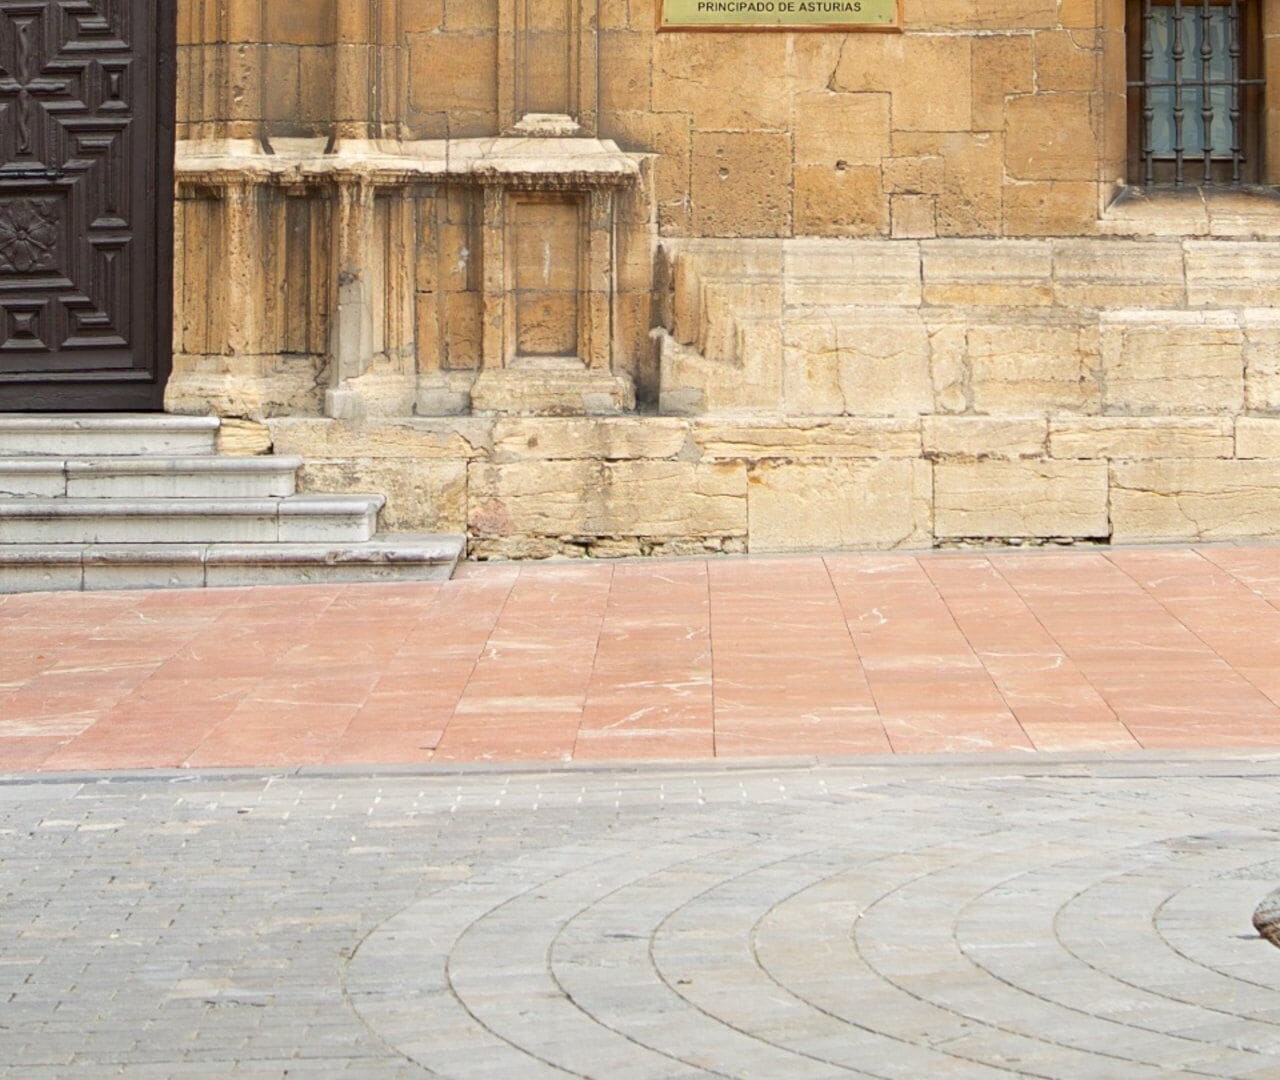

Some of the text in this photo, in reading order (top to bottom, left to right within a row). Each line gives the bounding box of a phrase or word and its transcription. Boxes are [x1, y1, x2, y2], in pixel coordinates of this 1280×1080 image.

[697, 1, 862, 12] PRINCIPADO DE ASTURIAS
